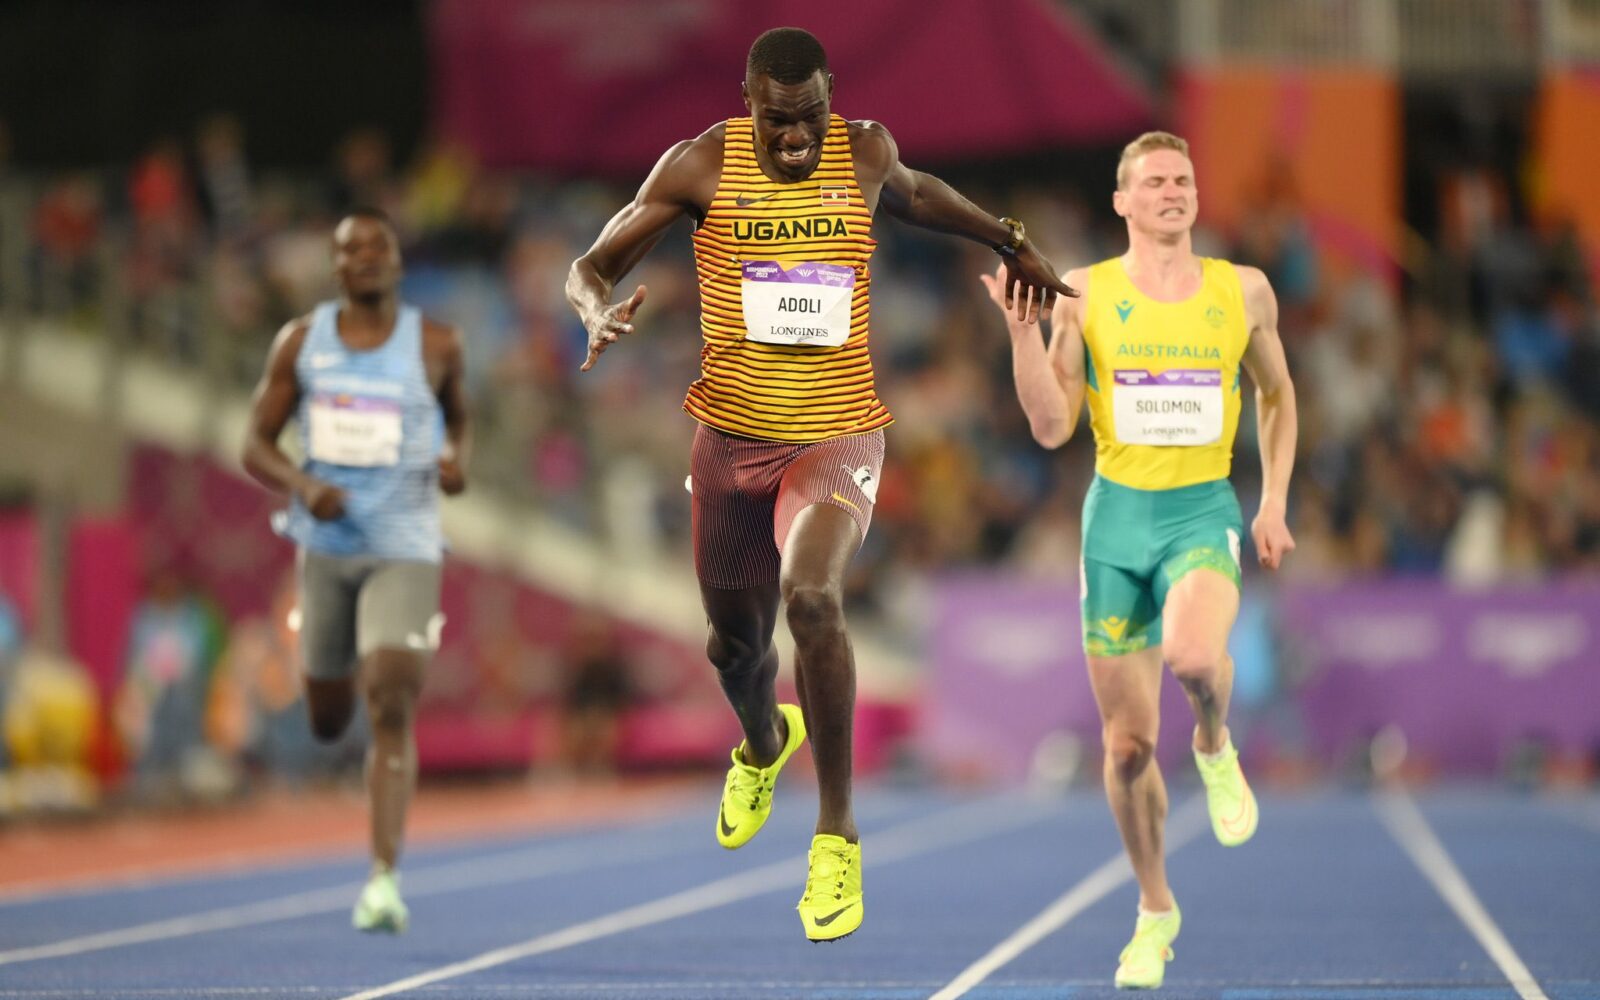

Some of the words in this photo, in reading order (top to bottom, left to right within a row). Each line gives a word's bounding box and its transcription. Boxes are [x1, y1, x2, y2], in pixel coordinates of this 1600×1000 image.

[734, 218, 848, 240] UGANDA
[778, 297, 821, 313] ADOLI
[770, 326, 829, 337] LONGINES
[1117, 344, 1221, 359] AUSTRALIA
[1136, 400, 1201, 414] SOLOMON
